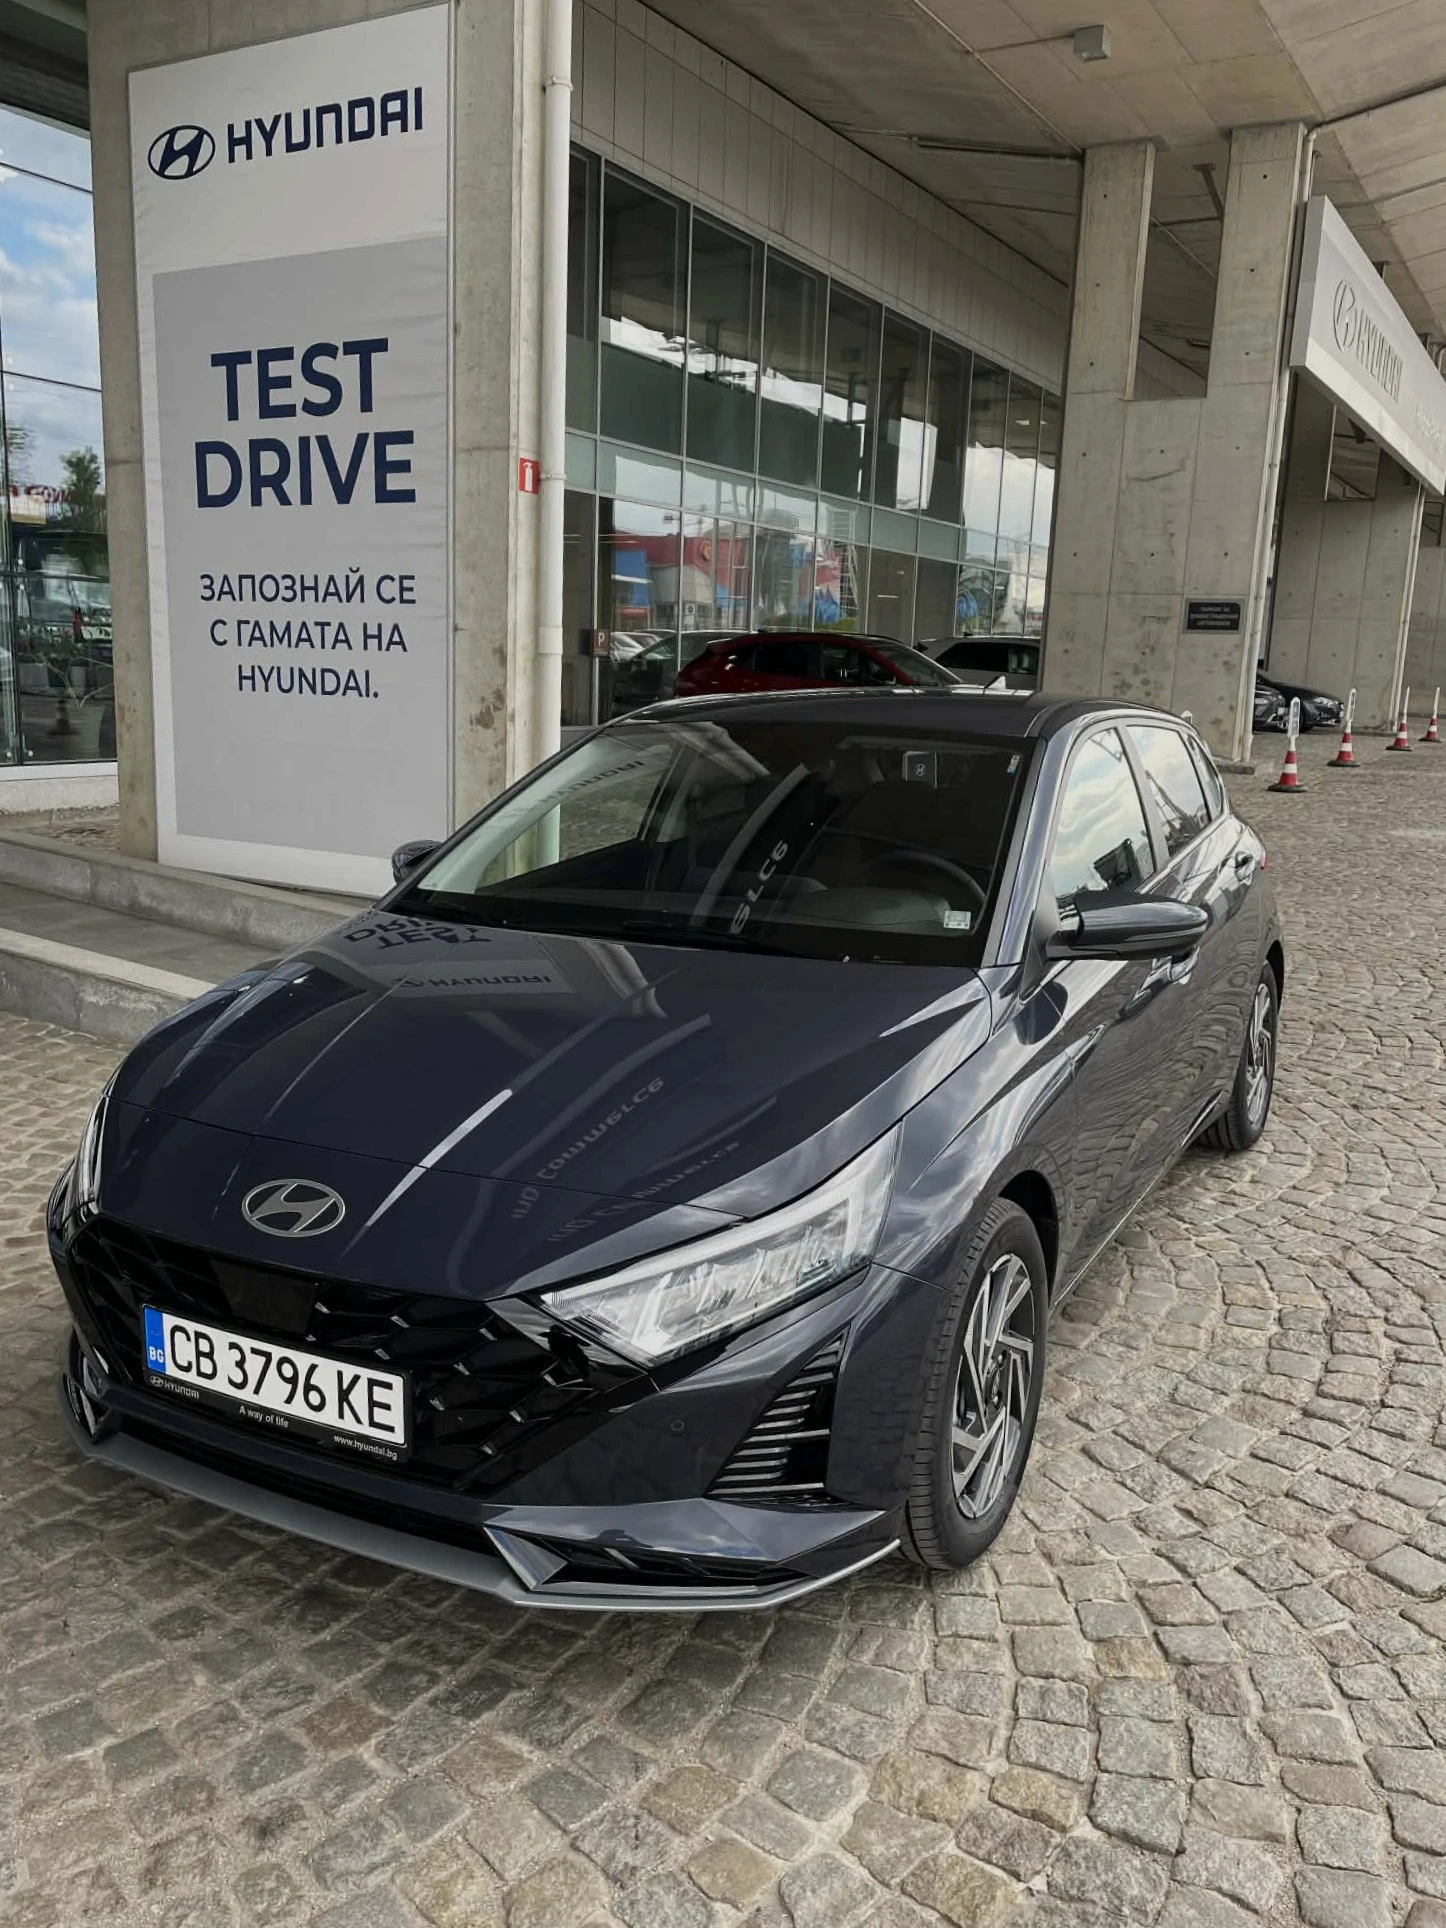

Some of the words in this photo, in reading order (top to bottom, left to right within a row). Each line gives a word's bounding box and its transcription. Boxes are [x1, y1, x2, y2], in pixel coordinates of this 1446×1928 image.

[227, 86, 422, 163] HYUNDAI
[211, 338, 388, 421] TEST
[195, 430, 416, 508] DRIVE
[200, 566, 365, 603] ЗАПОЗНАЙ
[376, 574, 416, 604] СЕ
[210, 619, 228, 646] С
[236, 620, 353, 651] ГАМАТА
[363, 622, 408, 652] НА
[238, 664, 379, 699] HYUNDAI.
[149, 1346, 165, 1363] BG
[164, 1382, 199, 1400] HYUNDAI
[227, 1341, 326, 1413] 3796
[239, 1405, 246, 1415] A
[247, 1408, 263, 1423] way
[265, 1412, 274, 1423] of
[276, 1415, 289, 1428] life
[333, 1435, 398, 1461] www.hyundai.bg
